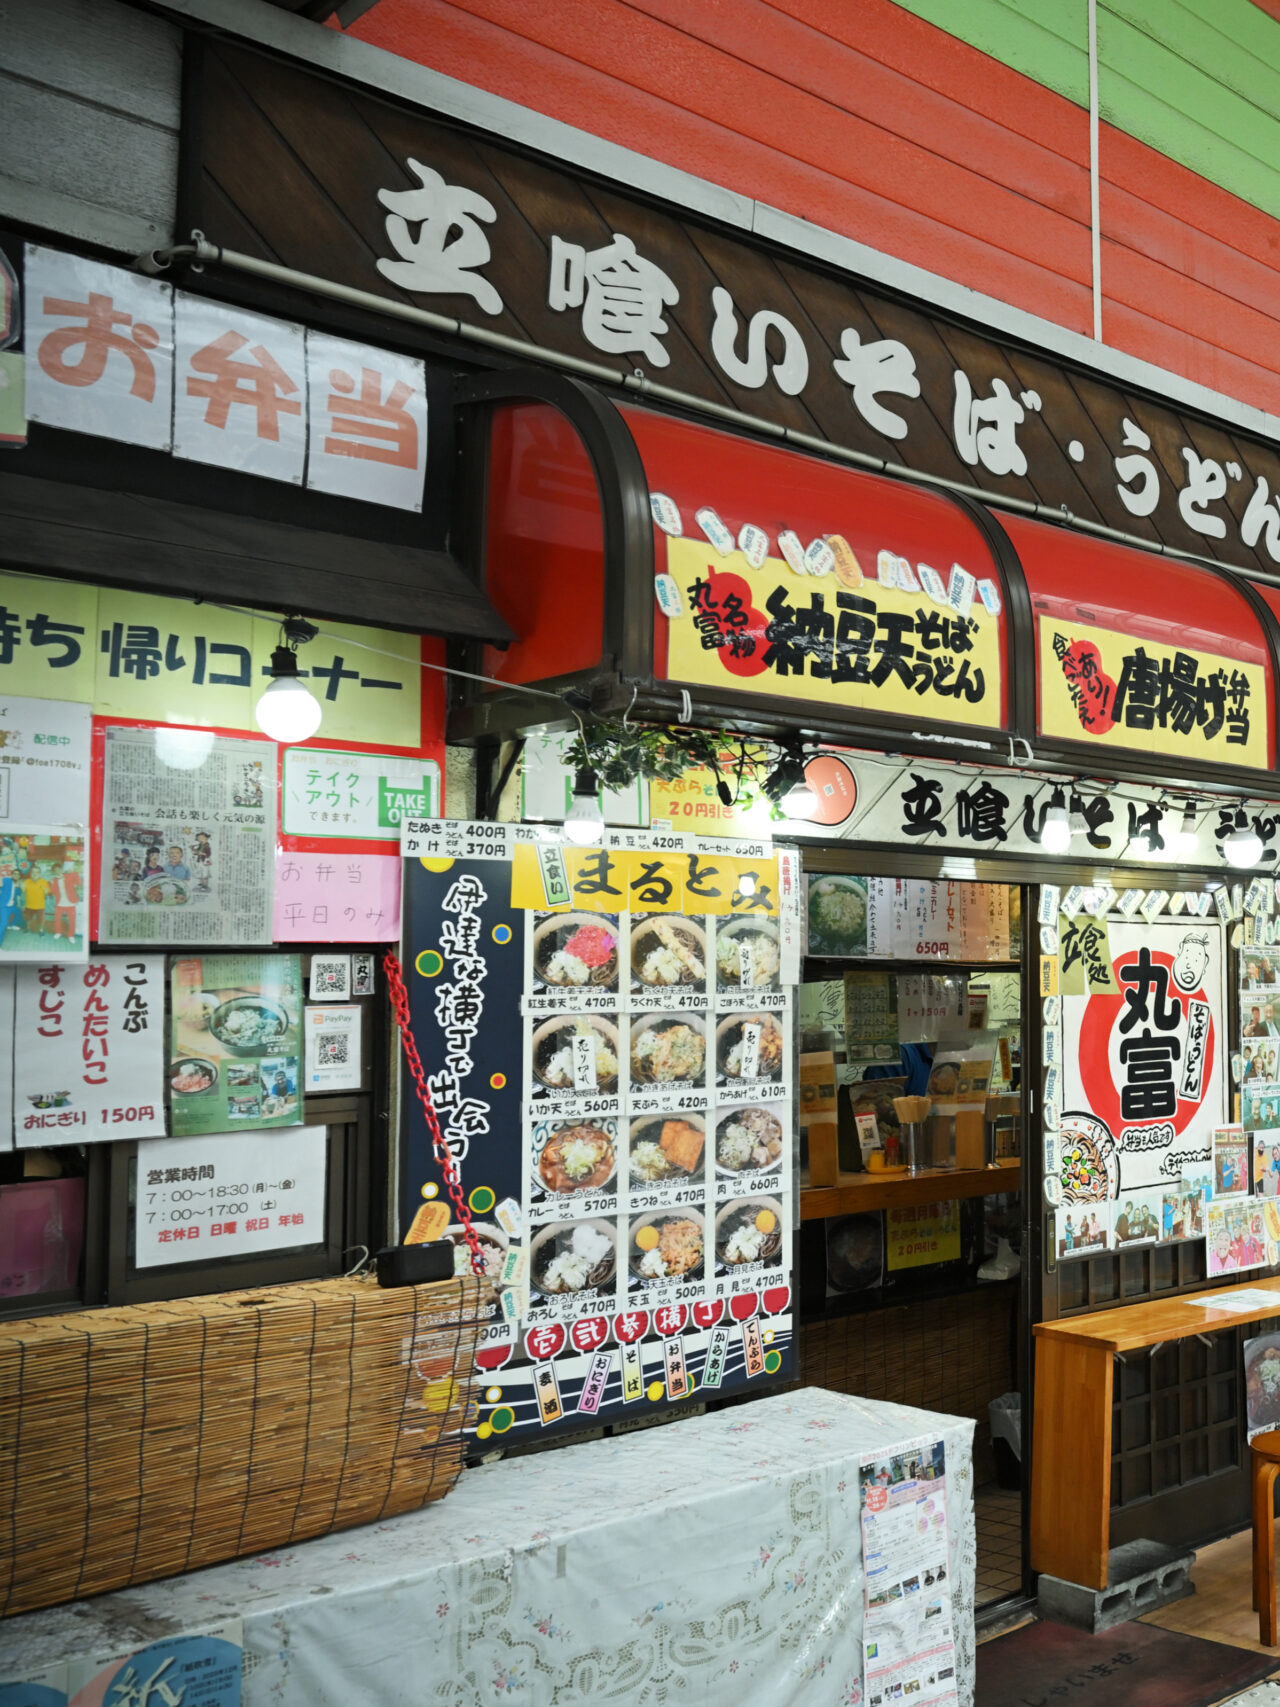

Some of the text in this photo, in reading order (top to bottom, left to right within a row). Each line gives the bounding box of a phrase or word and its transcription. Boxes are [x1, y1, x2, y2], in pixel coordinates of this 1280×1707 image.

[37, 292, 418, 471] お弁当
[687, 577, 725, 651] 丸富
[722, 593, 757, 659] 名物
[762, 585, 980, 689] 納豆天 そば
[912, 651, 986, 704] うどん
[1053, 632, 1095, 729] 食べごたえ
[1112, 647, 1229, 741] 唐揚げ
[1226, 670, 1250, 746] 弁当
[306, 769, 360, 788] テイク
[306, 790, 360, 808] アウト
[384, 792, 426, 810] TAKE
[154, 808, 266, 824] 会話も楽しく元気の源
[407, 821, 442, 834] たぬき
[466, 825, 506, 839] 400円
[466, 842, 506, 857] 370円
[652, 836, 684, 850] 420円
[281, 863, 364, 884] お弁当
[543, 847, 566, 896] 立食い
[573, 848, 775, 912] まるとみ
[283, 903, 386, 930] 平日のみ
[915, 941, 950, 956] 650円
[37, 965, 63, 1038] すじこ
[122, 962, 148, 1034] こんぶ
[585, 996, 616, 1008] 470円
[630, 997, 662, 1008] ちくわ天
[678, 996, 708, 1008] 470円
[760, 995, 786, 1006] 470円
[82, 965, 109, 1085] めんたいこ
[324, 1014, 352, 1024] PayPay
[1119, 947, 1181, 1121] 丸富
[1184, 1004, 1206, 1092] そばうどん
[632, 1099, 659, 1111] 天ぷら
[678, 1095, 708, 1108] 420円
[720, 1086, 786, 1100] からあげ 610円
[23, 1105, 155, 1131] おにぎり 150円
[528, 1102, 562, 1117] いか天
[584, 1098, 619, 1112] 560円
[147, 1164, 215, 1185] 営業時間
[717, 1184, 727, 1195] 肉
[750, 1177, 779, 1191] 660円
[528, 1206, 555, 1218] カレー
[584, 1196, 617, 1212] 570円
[630, 1196, 658, 1208] きつね
[675, 1188, 705, 1203] 470円
[158, 1226, 200, 1243] 定休日
[210, 1221, 237, 1237] 日曜
[245, 1217, 270, 1232] 祝日
[755, 1274, 784, 1288] 470円
[628, 1293, 650, 1307] 天玉
[675, 1284, 706, 1300] 500円
[527, 1308, 558, 1322] おろし
[580, 1298, 616, 1315] 470円
[707, 1331, 725, 1383] からあげ
[747, 1322, 761, 1371] てんぷら
[625, 1351, 640, 1392] そば
[668, 1343, 684, 1392] お弁当
[584, 1357, 606, 1409] おにぎり
